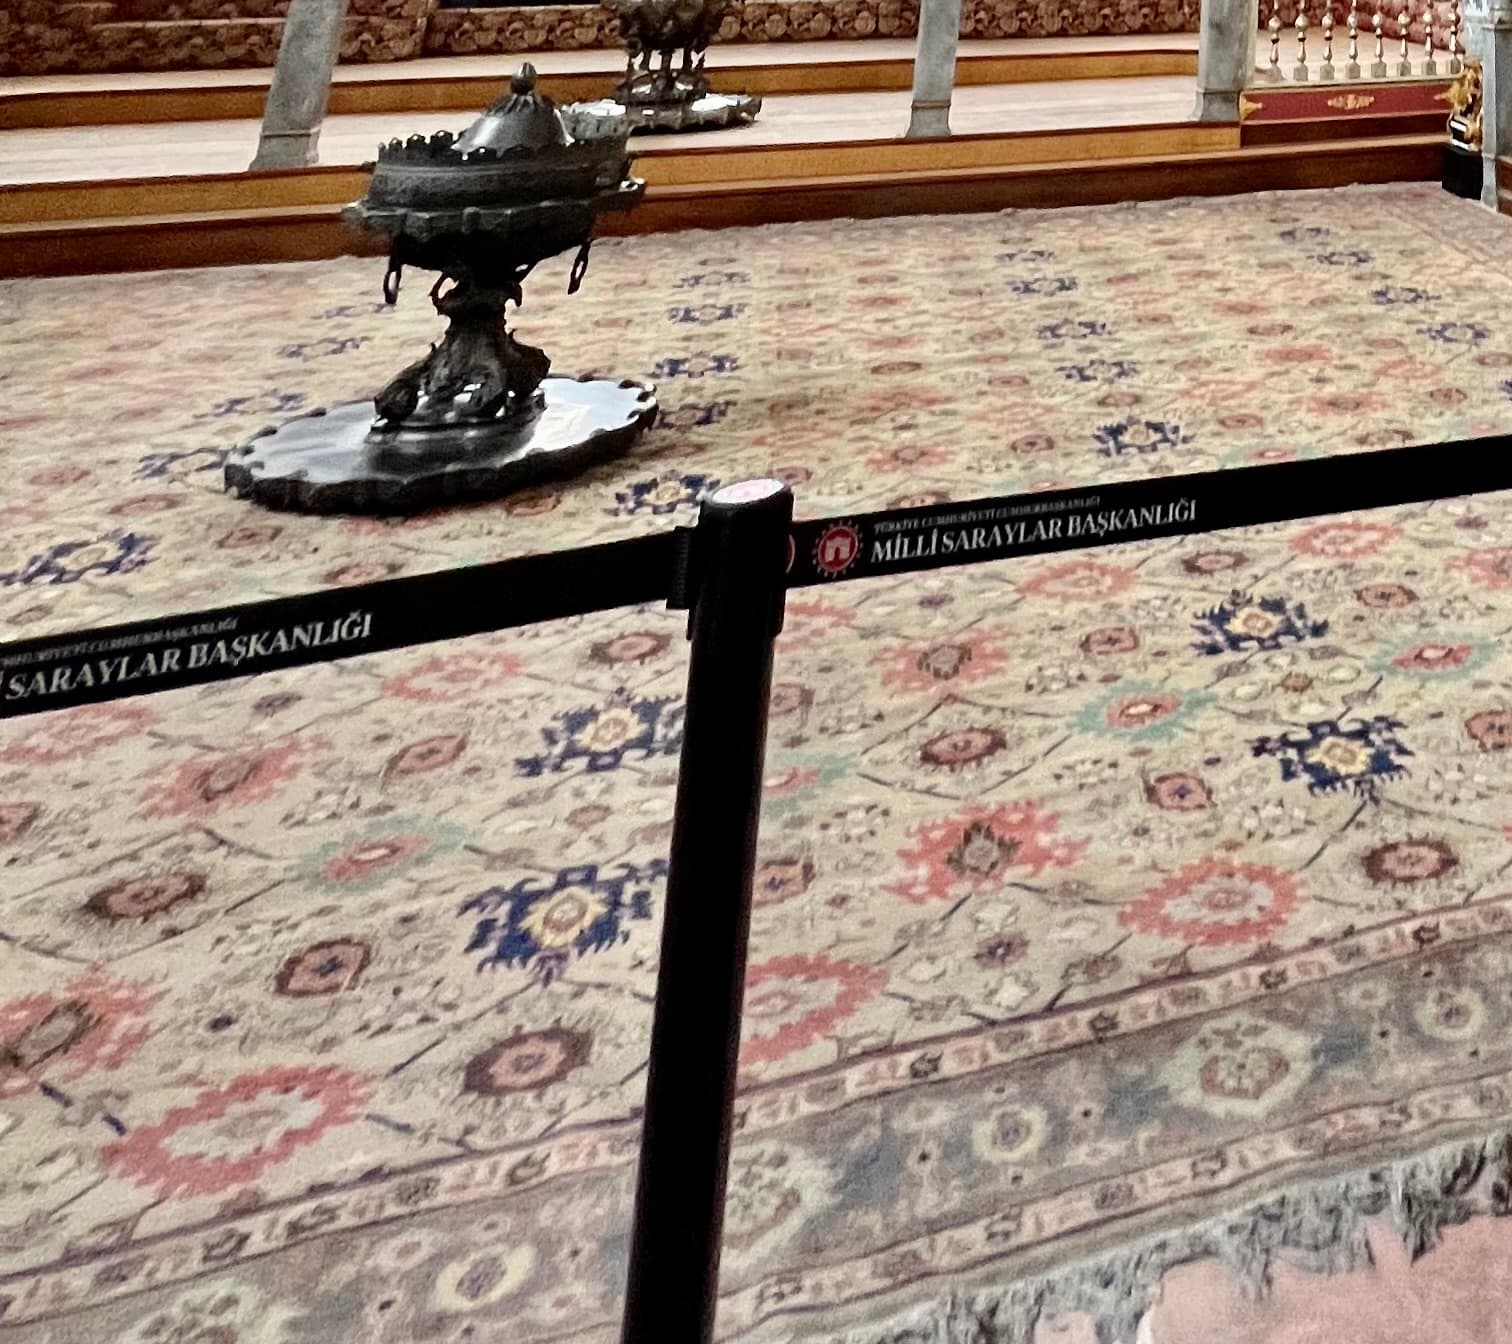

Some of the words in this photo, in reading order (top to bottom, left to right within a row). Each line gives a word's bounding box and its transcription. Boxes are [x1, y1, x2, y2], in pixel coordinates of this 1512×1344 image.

[870, 527, 937, 564] MİLLİ
[941, 516, 1062, 554] SARAYLAR
[1066, 498, 1198, 537] BAŞKANLIĞI
[5, 652, 181, 700] SARAYLAR
[188, 609, 373, 666] BAŞKANLIĞI
